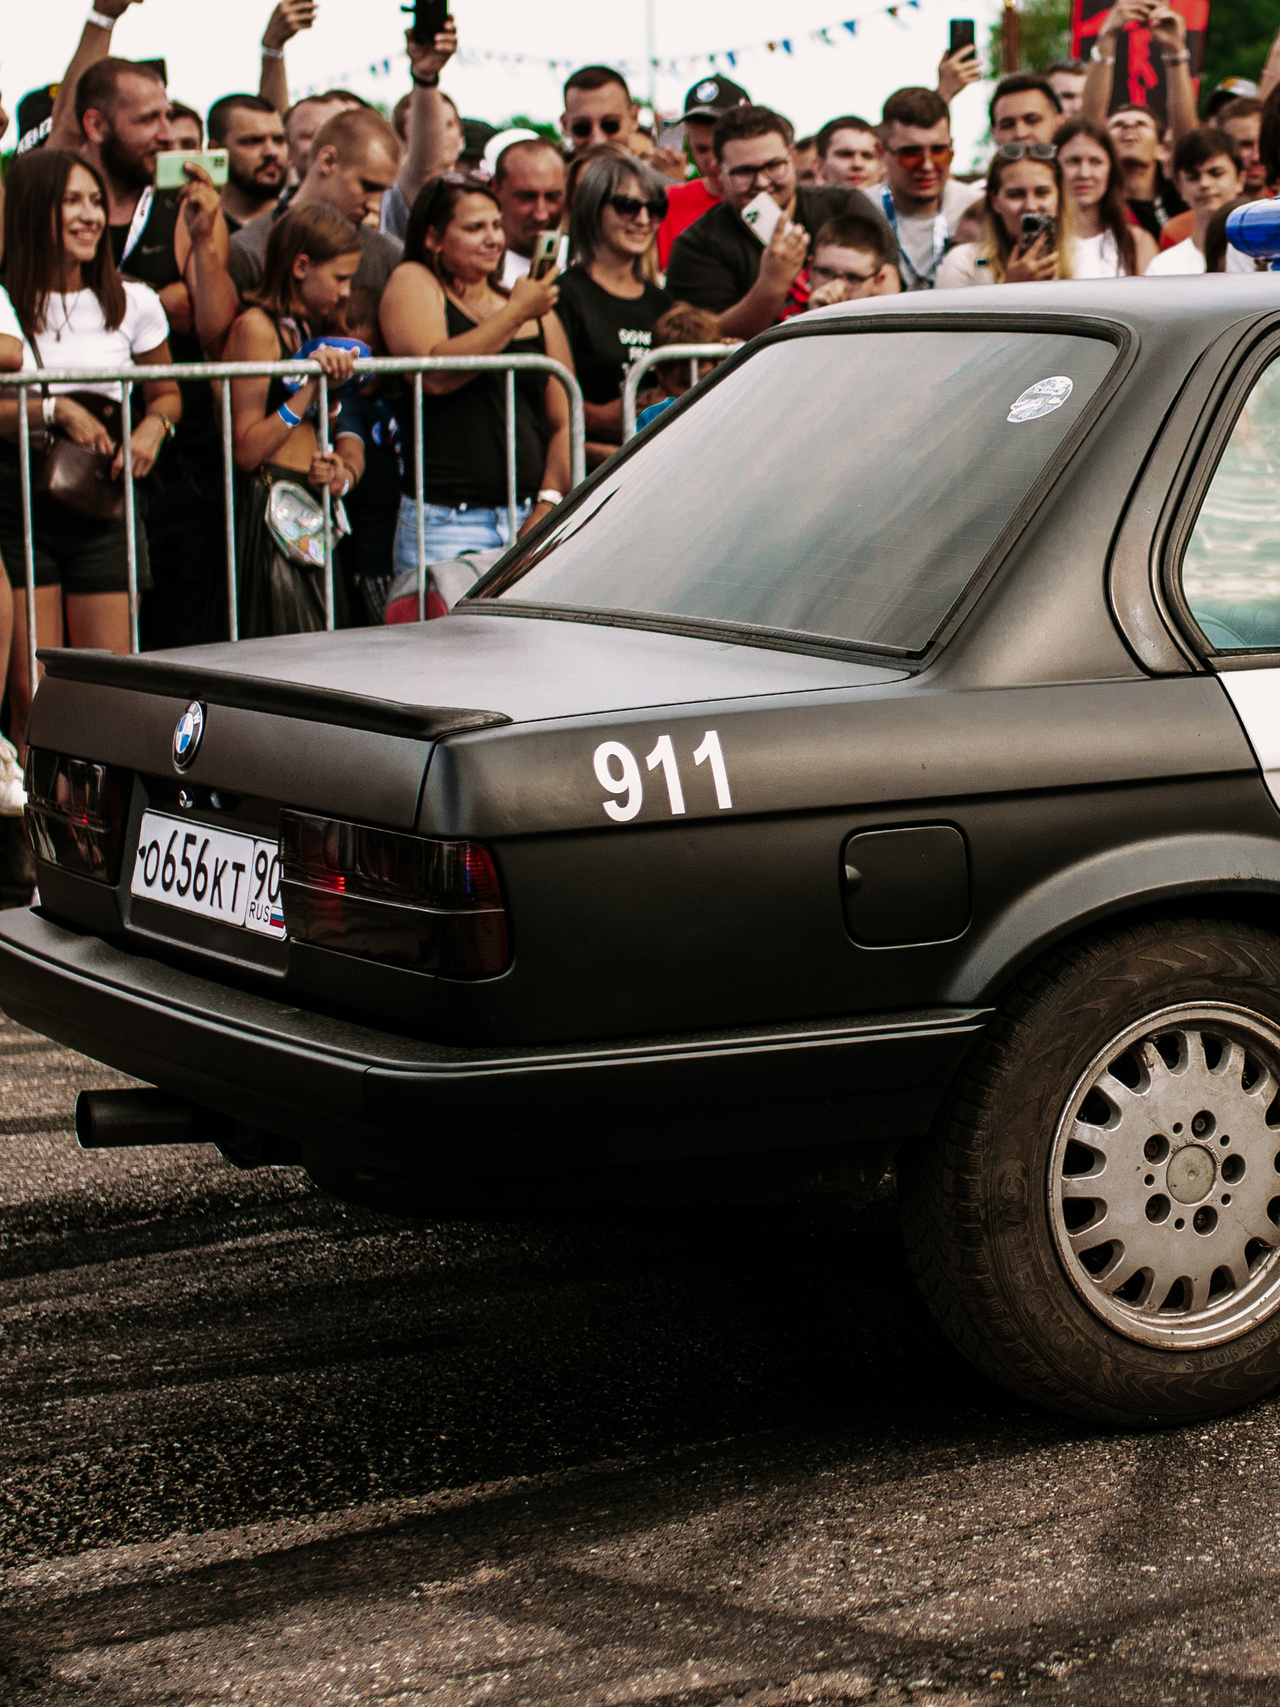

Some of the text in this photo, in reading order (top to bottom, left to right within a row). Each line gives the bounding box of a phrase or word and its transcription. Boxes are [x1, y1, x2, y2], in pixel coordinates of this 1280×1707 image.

[592, 730, 733, 822] 911
[249, 901, 270, 923] RUS
[254, 849, 282, 903] 90
[1000, 1174, 1092, 1371] NORD-TRAC
